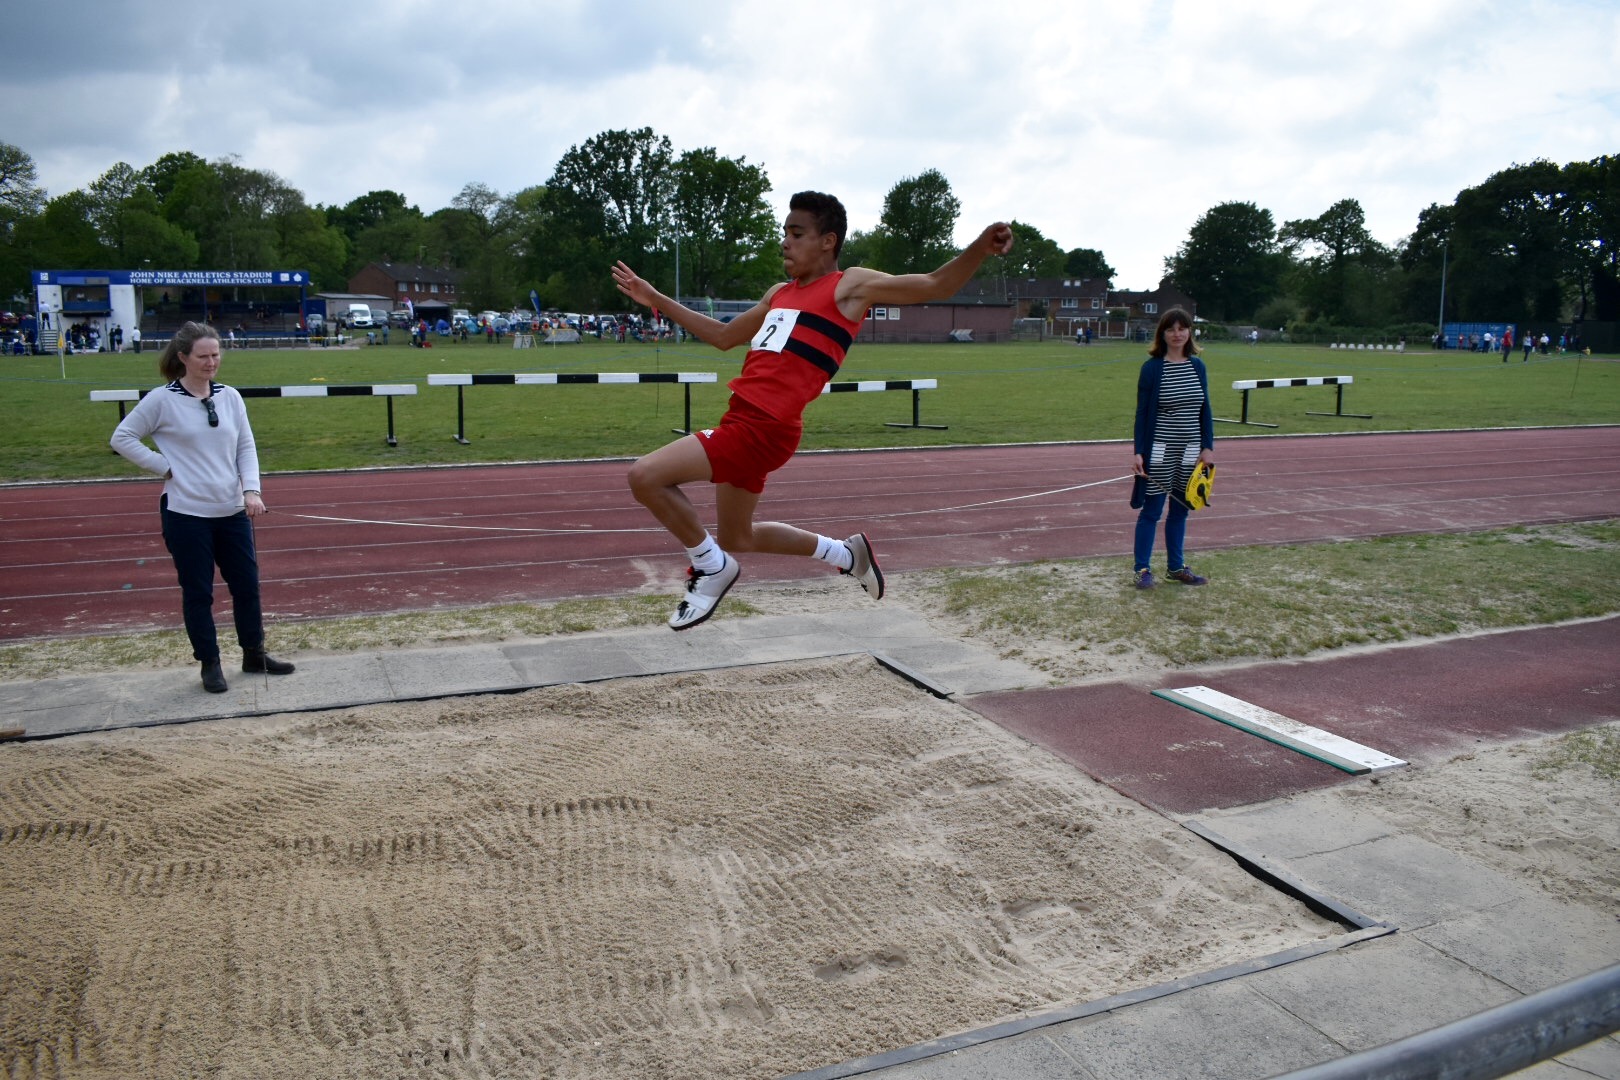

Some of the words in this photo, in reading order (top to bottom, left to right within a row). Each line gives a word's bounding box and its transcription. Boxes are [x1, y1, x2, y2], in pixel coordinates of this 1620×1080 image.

[130, 271, 154, 279] JOHN
[158, 271, 179, 279] NIKE
[182, 271, 230, 279] ATHLETICS
[234, 271, 272, 279] STADIUM
[759, 324, 777, 347] 2
